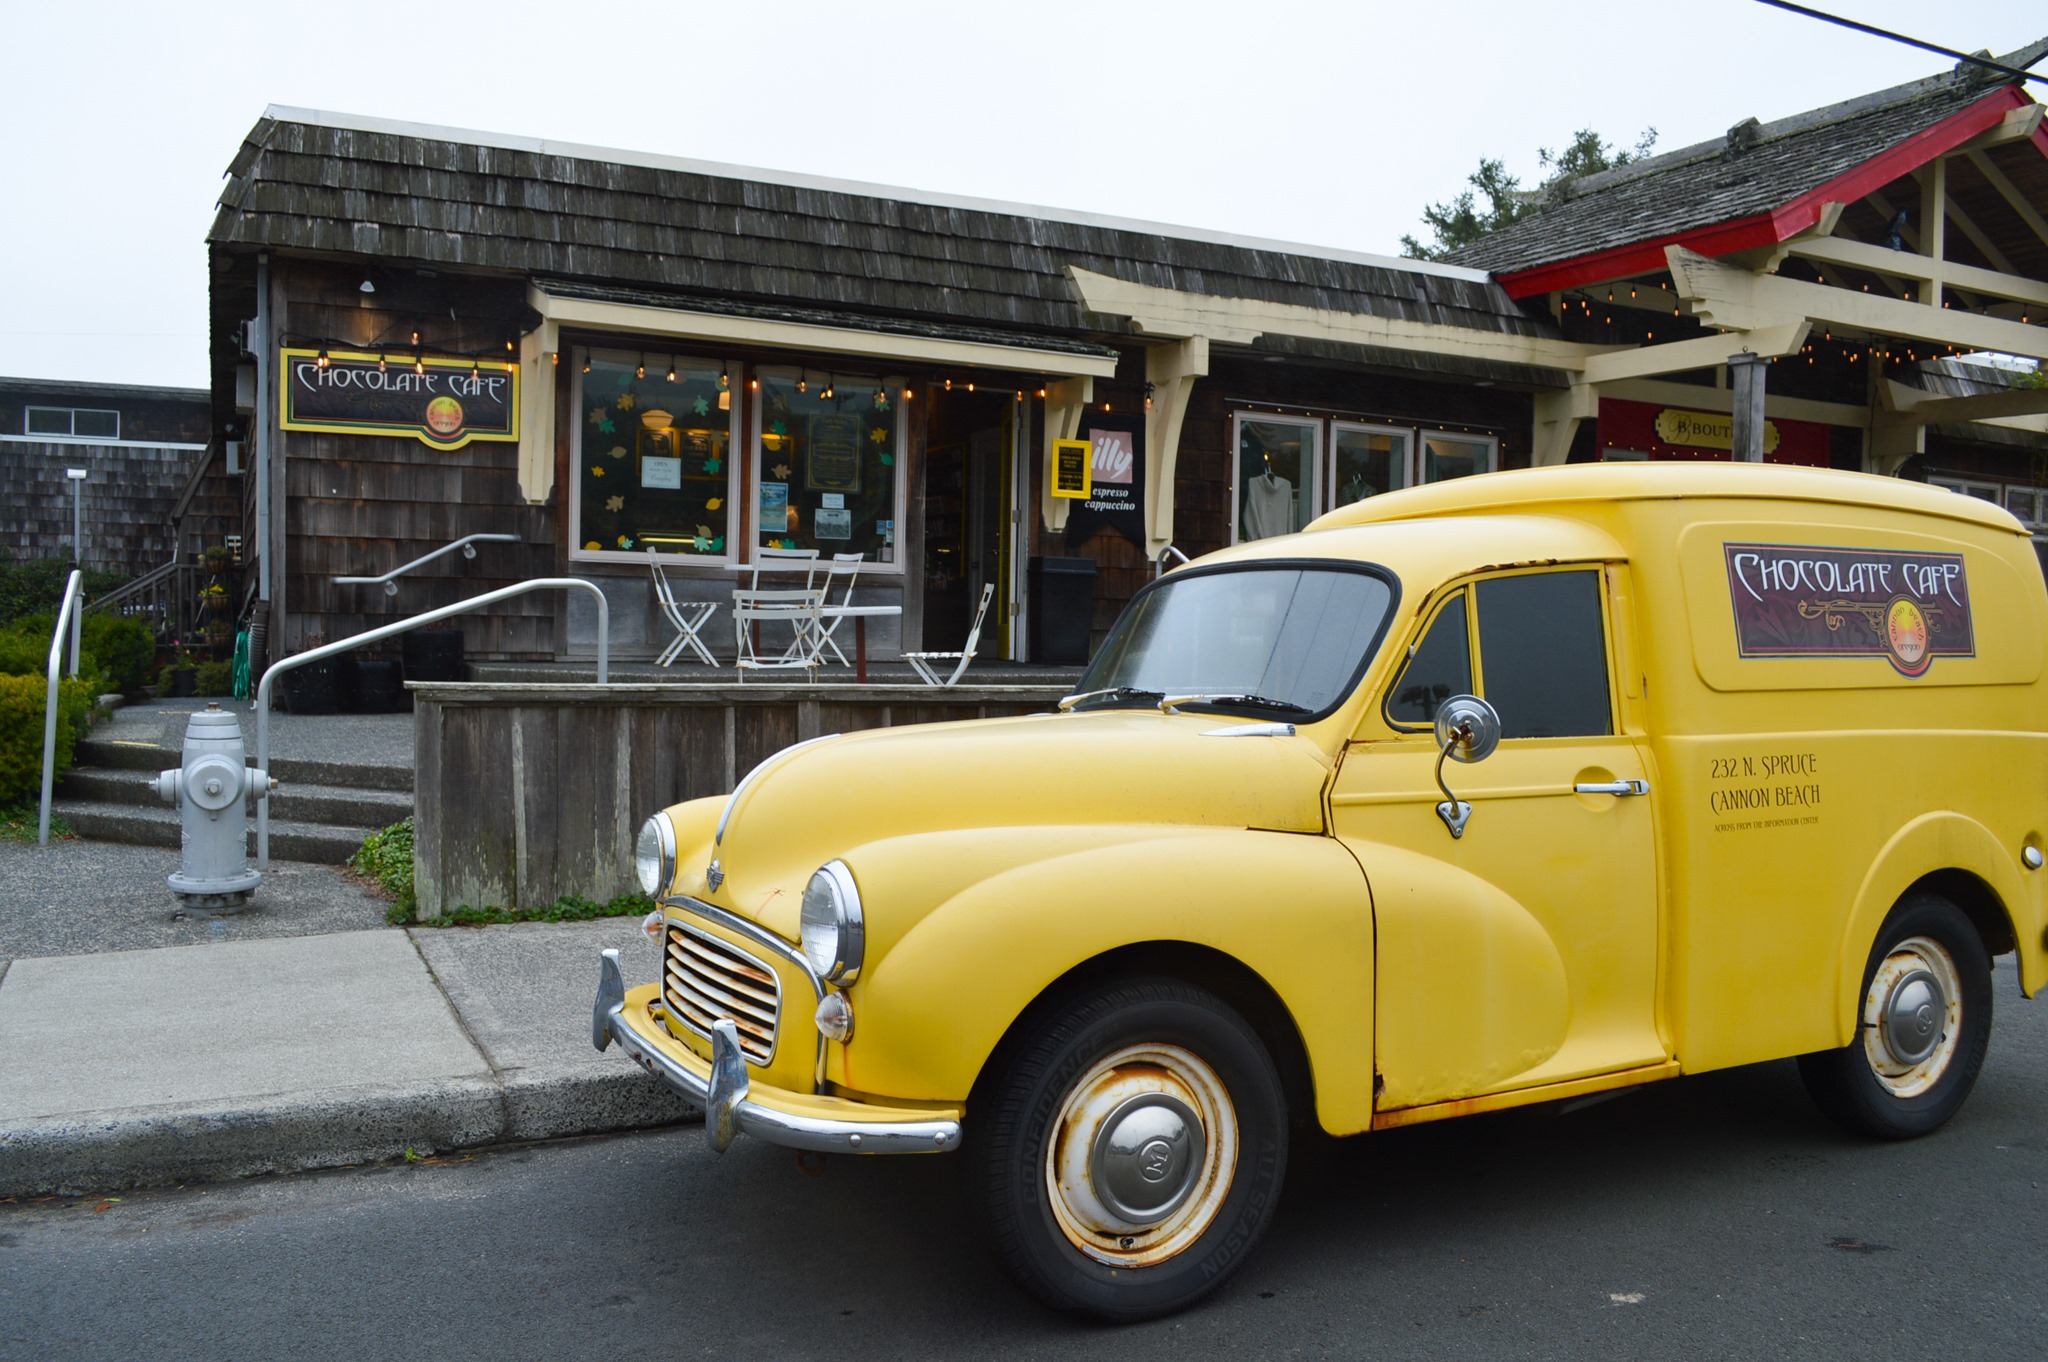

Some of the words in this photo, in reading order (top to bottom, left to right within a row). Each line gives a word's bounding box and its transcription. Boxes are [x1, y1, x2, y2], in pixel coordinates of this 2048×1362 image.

[296, 364, 438, 393] CHOCOLATE
[448, 375, 506, 404] CAFE
[1692, 422, 1734, 439] BOUT
[1091, 436, 1133, 480] illy
[1084, 500, 1136, 512] cappuccino
[1092, 487, 1129, 499] espresso
[1734, 553, 1893, 602] CHOCOLATE
[1902, 563, 1962, 608] CAFE
[1711, 758, 1738, 779] 232
[1743, 757, 1757, 777] N.
[1761, 753, 1817, 780] SPRUCE
[1710, 787, 1770, 816] CANNON
[1775, 784, 1820, 808] BEACH
[1736, 821, 1752, 830] FROM
